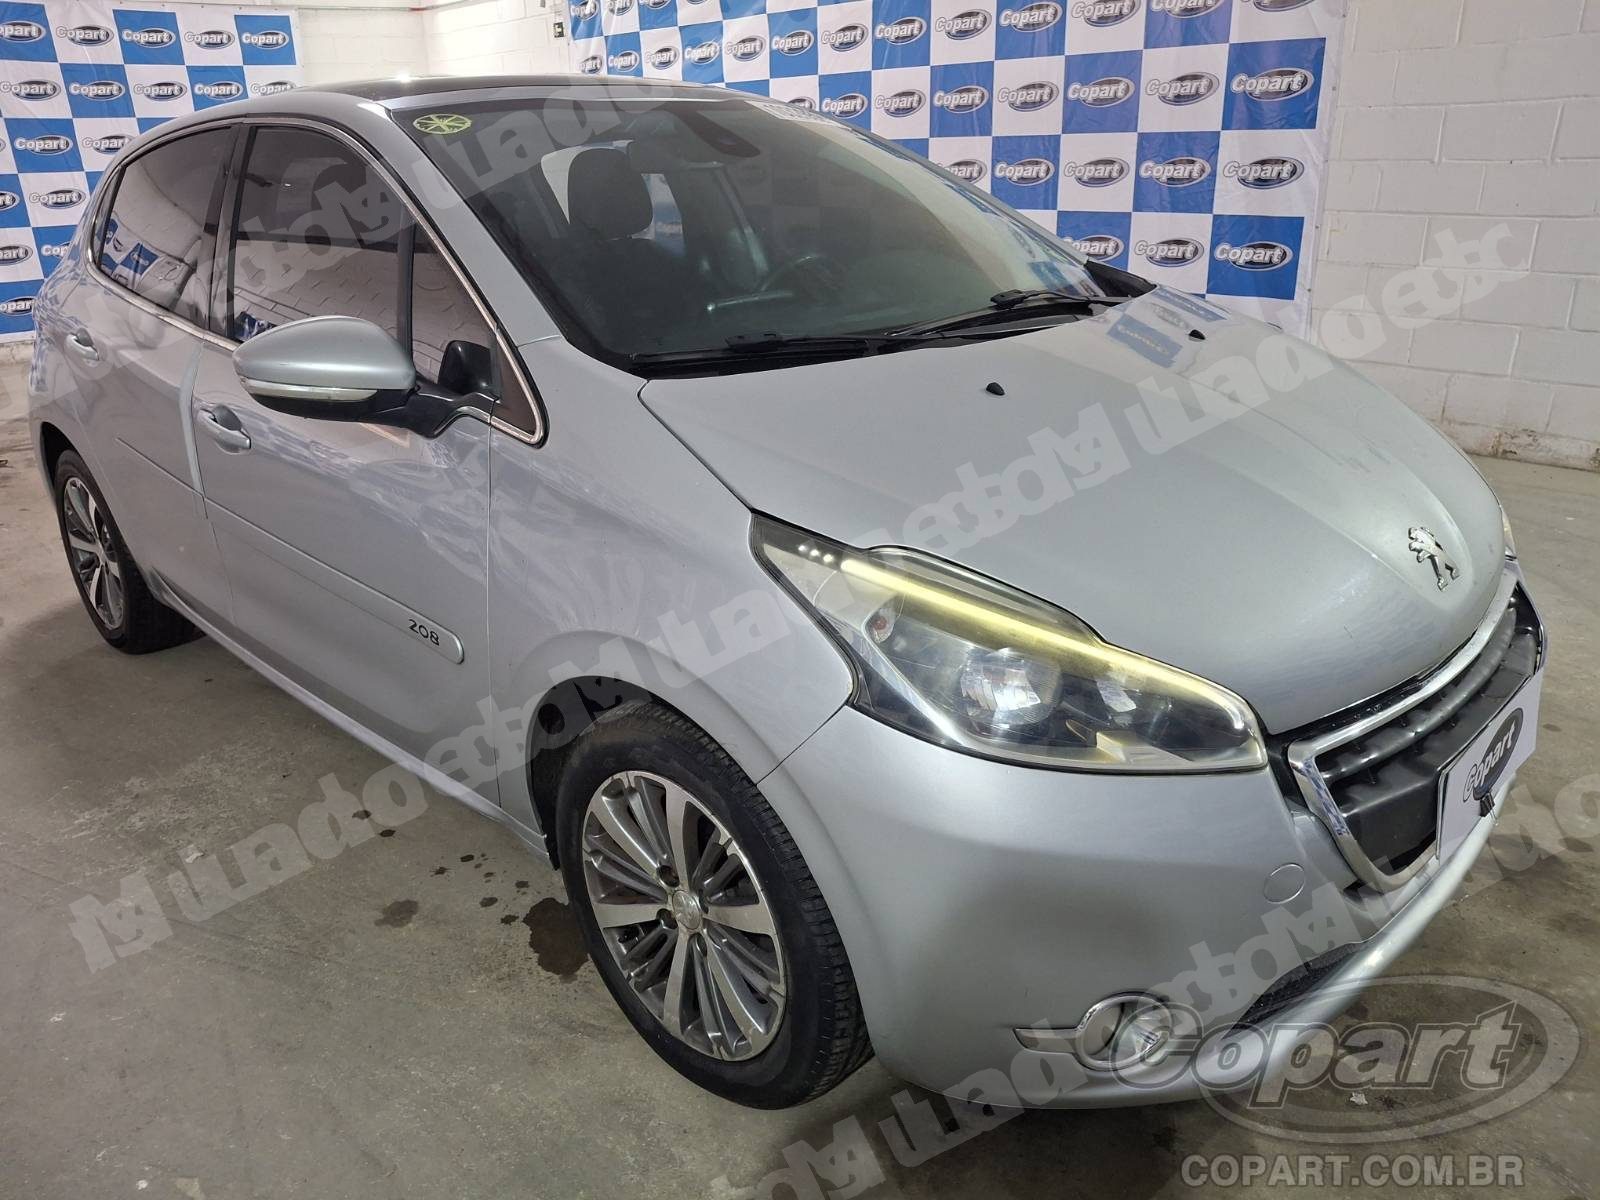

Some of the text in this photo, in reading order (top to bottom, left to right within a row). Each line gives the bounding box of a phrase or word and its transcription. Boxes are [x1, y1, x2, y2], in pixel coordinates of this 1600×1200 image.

[1000, 6, 1054, 27] Copart
[1071, 1, 1130, 21] Copart
[56, 26, 108, 40] Copart
[875, 22, 920, 42] Copart
[935, 14, 984, 34] Copart
[121, 28, 171, 44] Copart
[184, 31, 229, 44] Copart
[242, 32, 284, 45] Copart
[772, 36, 809, 53] Copart
[821, 30, 863, 46] Copart
[685, 43, 715, 62] Copart
[726, 41, 762, 57] Copart
[608, 54, 635, 70] Copart
[645, 50, 674, 68] Copart
[0, 80, 54, 97] Copart
[68, 81, 120, 97] Copart
[133, 83, 180, 97] Copart
[194, 82, 238, 97] Copart
[1068, 81, 1127, 102] Copart
[1145, 77, 1210, 99] Copart
[1231, 72, 1306, 95] Copart
[875, 94, 920, 113] Copart
[933, 90, 982, 109] Copart
[998, 85, 1052, 106] Copart
[821, 98, 862, 114] Copart
[14, 136, 67, 152] Copart
[994, 161, 1048, 180] Copart
[1064, 161, 1120, 181] Copart
[1139, 160, 1202, 181] Copart
[1223, 160, 1294, 181] Copart
[29, 191, 79, 206] Copart
[1135, 240, 1195, 260] Copart
[1214, 243, 1285, 265] Copart
[408, 619, 440, 646] 208
[1463, 720, 1517, 803] Copart
